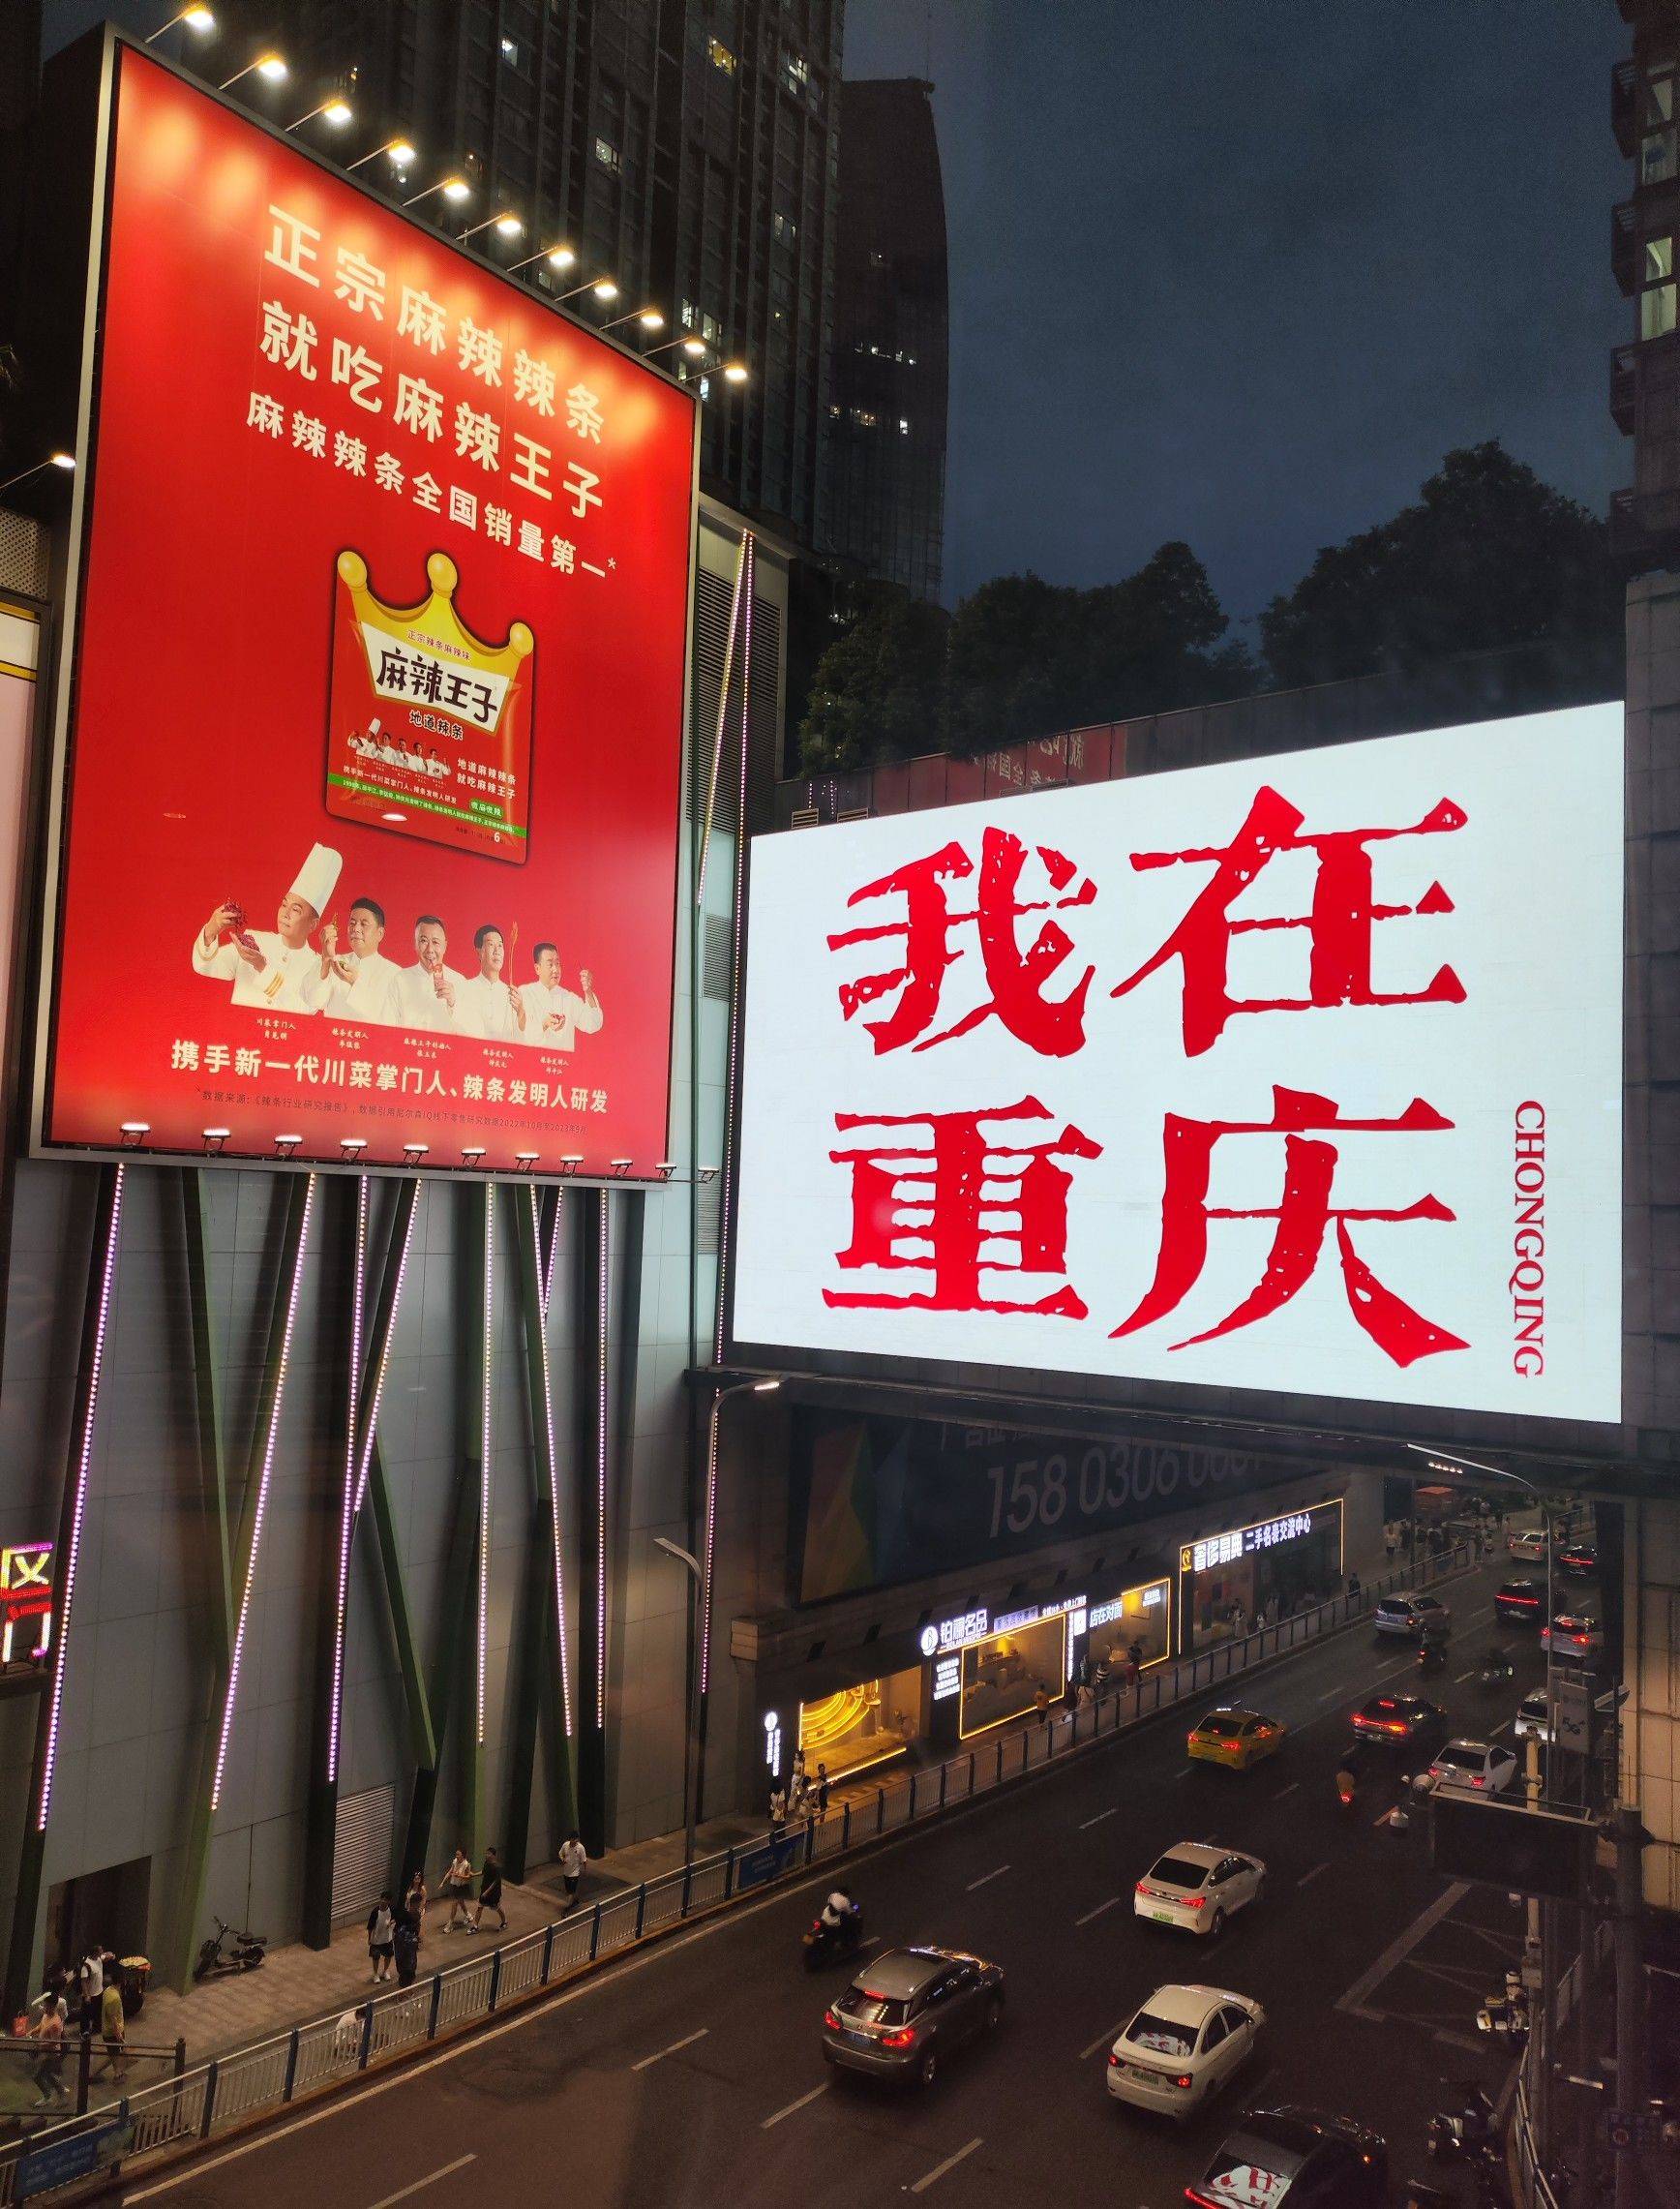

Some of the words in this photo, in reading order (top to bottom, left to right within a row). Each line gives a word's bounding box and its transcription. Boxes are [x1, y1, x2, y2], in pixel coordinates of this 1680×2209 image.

[259, 301, 604, 519] 就吃麻辣王子
[264, 203, 605, 445] 正宗麻辣辣条
[376, 646, 498, 723] 麻辣王子
[409, 710, 464, 740] 地道辣条
[826, 785, 1468, 1057] 我在
[171, 1039, 609, 1113] 携手新一代川菜掌门人、辣条发明人研发
[822, 1084, 1472, 1369] 重庆
[1509, 1101, 1546, 1378] CHONGQING
[987, 1454, 1068, 1538] 158
